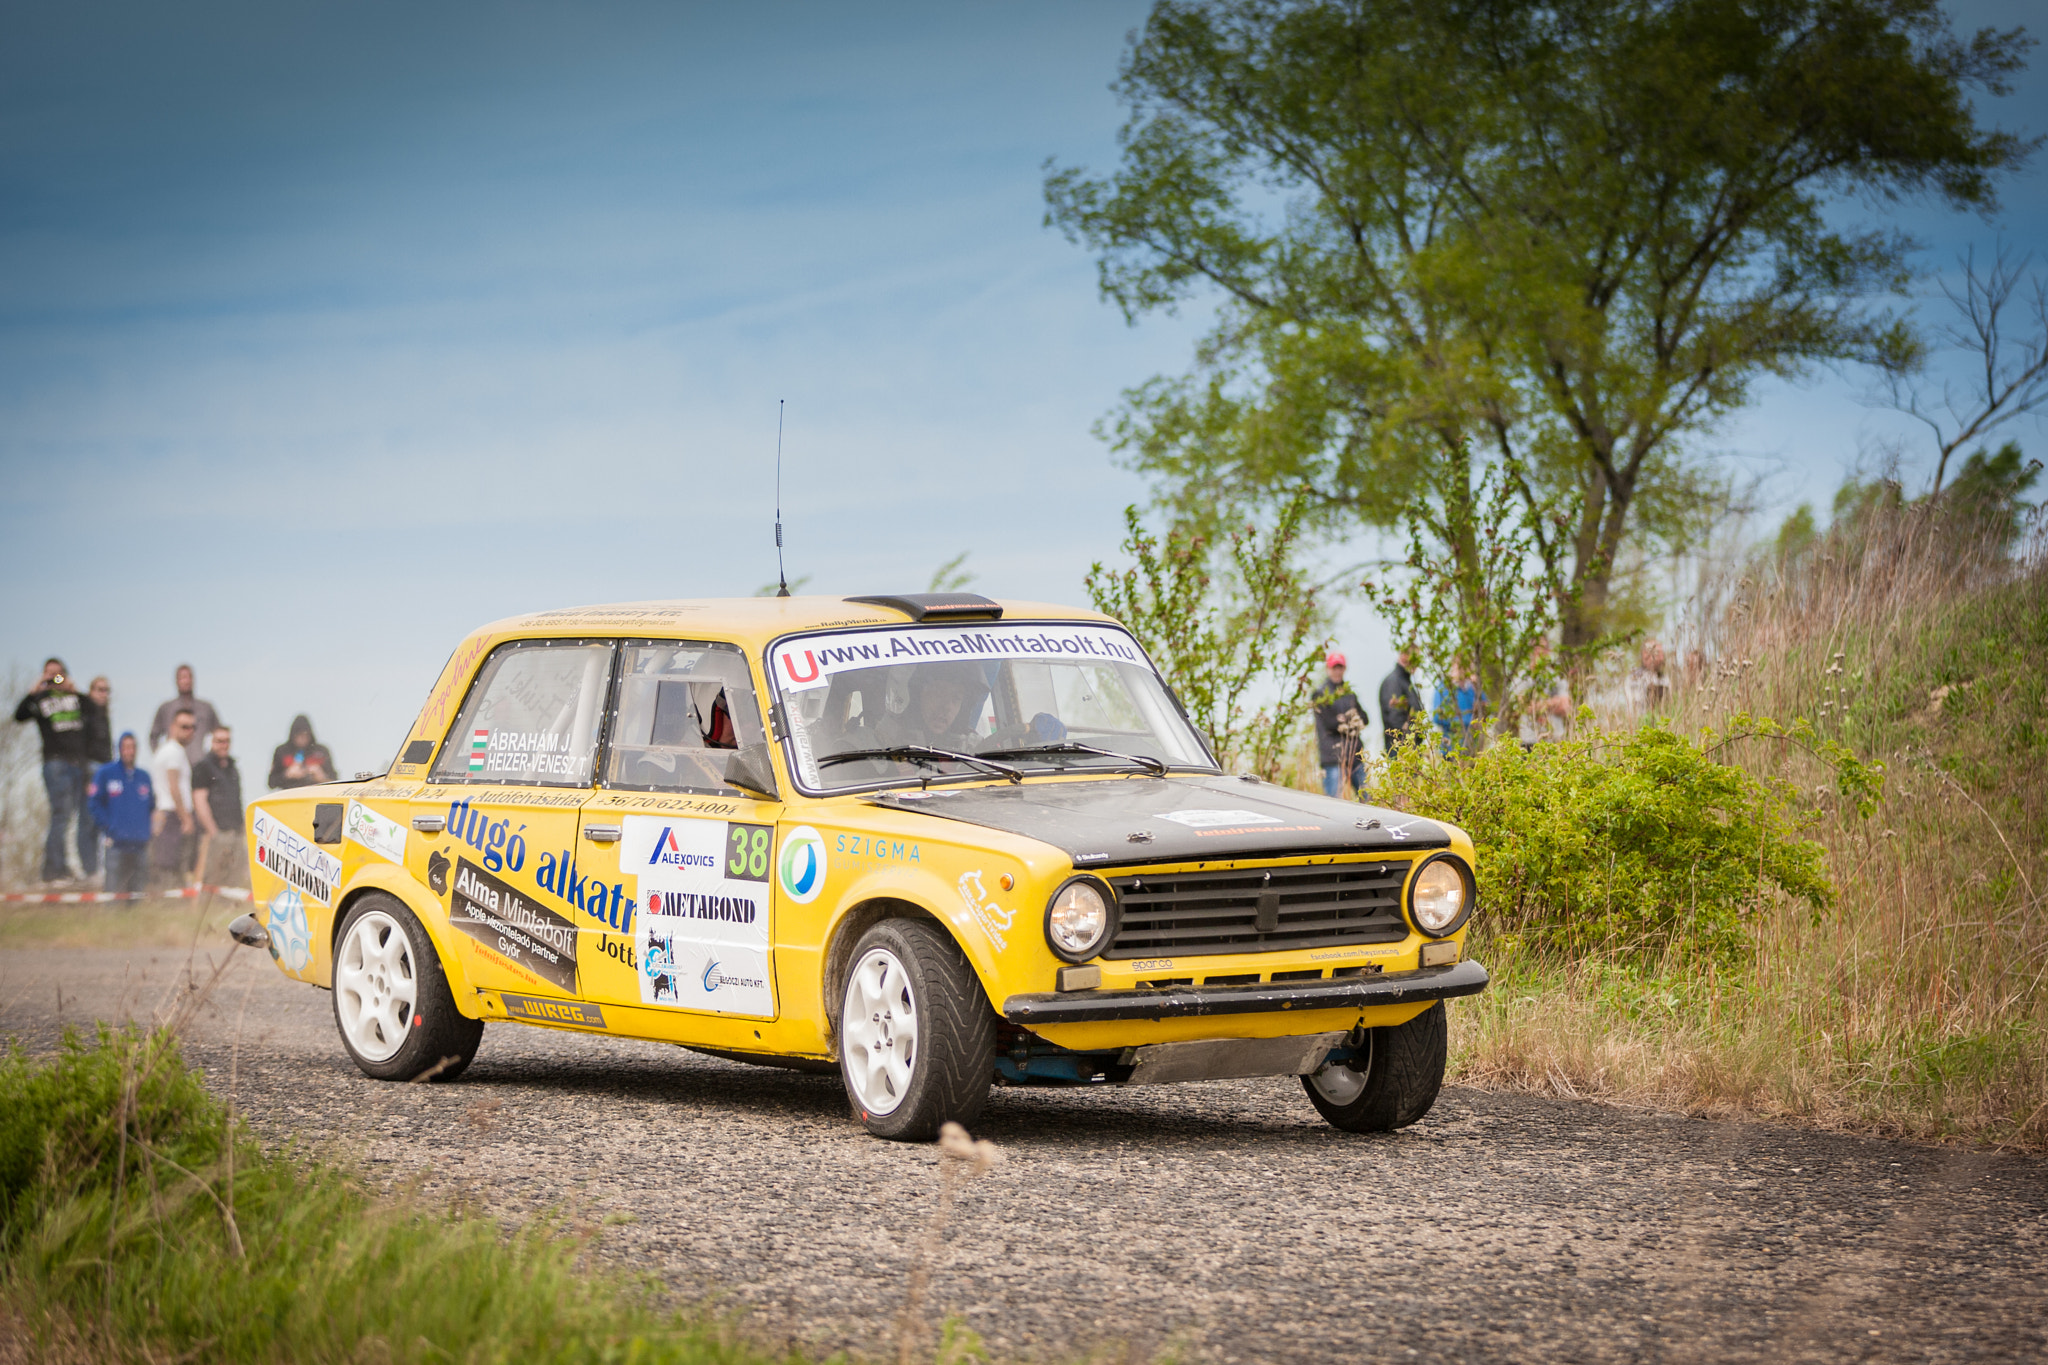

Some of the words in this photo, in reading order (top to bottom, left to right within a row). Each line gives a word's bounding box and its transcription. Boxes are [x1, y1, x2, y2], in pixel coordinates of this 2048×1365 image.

[782, 650, 820, 683] U
[487, 728, 559, 751] ÁBRAHÁM
[560, 733, 571, 752] J.
[486, 752, 577, 775] HEIZER-VENESZ
[578, 756, 587, 777] T.
[597, 795, 656, 808] +36/70
[447, 795, 527, 873] dugó
[836, 834, 920, 863] SZIGMA
[254, 818, 275, 841] 4V
[276, 828, 341, 883] REKLÁM
[661, 852, 715, 867] ALEXOVICS
[729, 827, 769, 877] 38
[266, 848, 329, 903] METABOND
[456, 867, 499, 911] Alma
[503, 892, 574, 956] Mintabolt
[662, 892, 756, 924] METABOND
[465, 901, 487, 922] Apple
[487, 914, 530, 952] viszonteladó
[531, 942, 559, 965] partner
[498, 937, 521, 958] Győr
[1132, 959, 1173, 970] sparco
